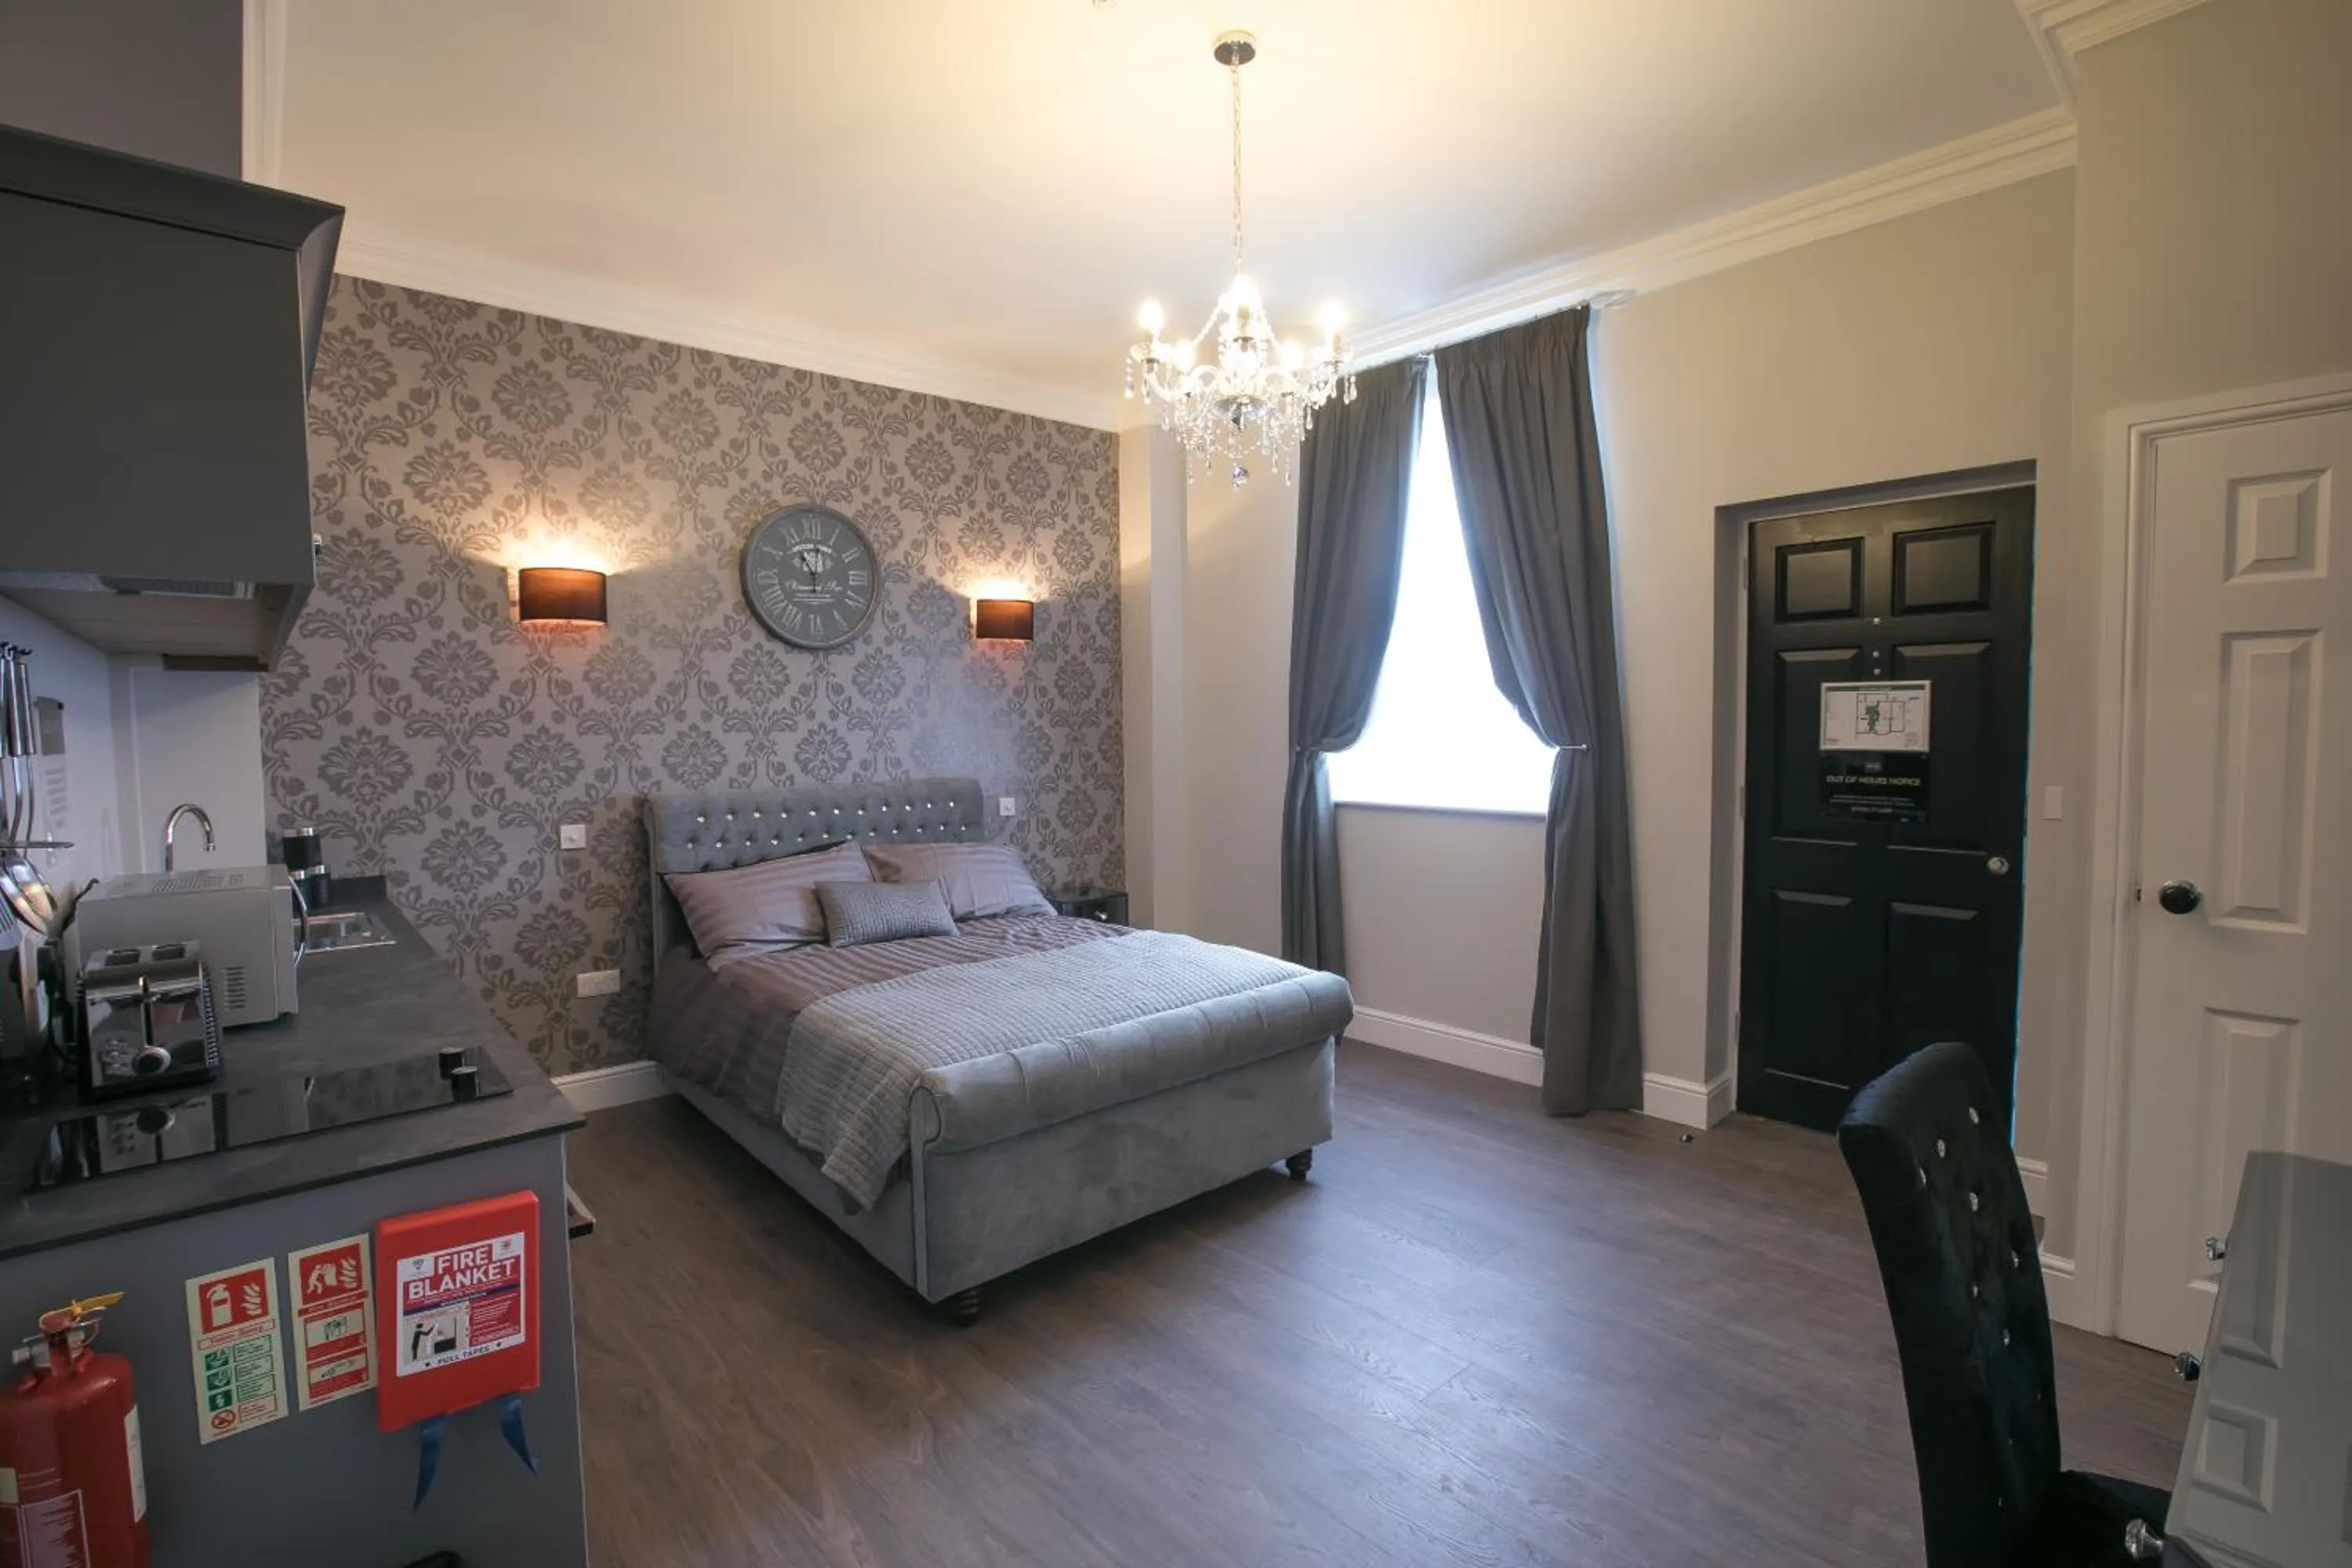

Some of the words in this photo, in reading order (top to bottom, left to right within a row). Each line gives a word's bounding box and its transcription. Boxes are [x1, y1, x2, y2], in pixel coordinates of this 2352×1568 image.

[1826, 775, 1844, 783] OUT
[437, 1246, 488, 1274] FIRE
[408, 1258, 515, 1300] BLANKET
[437, 1354, 460, 1363] PULL
[463, 1345, 490, 1358] TAPES
